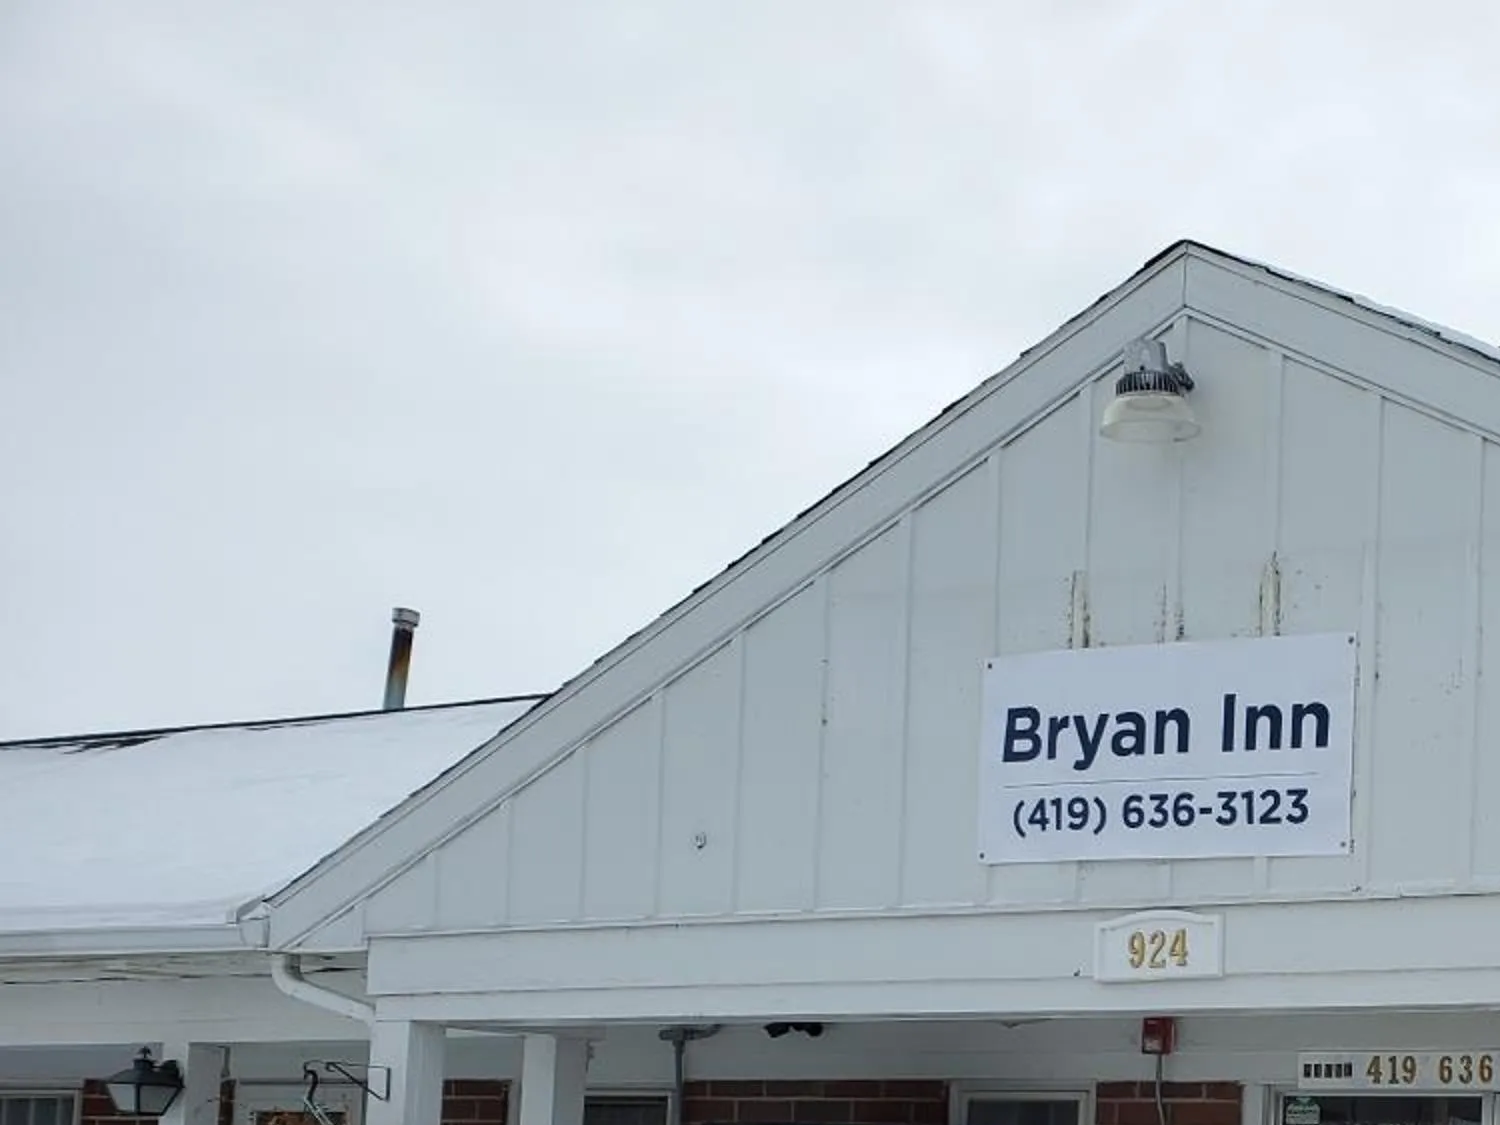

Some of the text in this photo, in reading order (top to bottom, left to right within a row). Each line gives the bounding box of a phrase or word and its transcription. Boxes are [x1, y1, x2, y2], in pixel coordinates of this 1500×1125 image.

[1002, 693, 1330, 771] Bryan Inn
[1013, 788, 1310, 838] (419) 636-3123
[1128, 929, 1188, 969] 924
[1366, 1055, 1417, 1084] 419
[1439, 1054, 1494, 1084] 636
